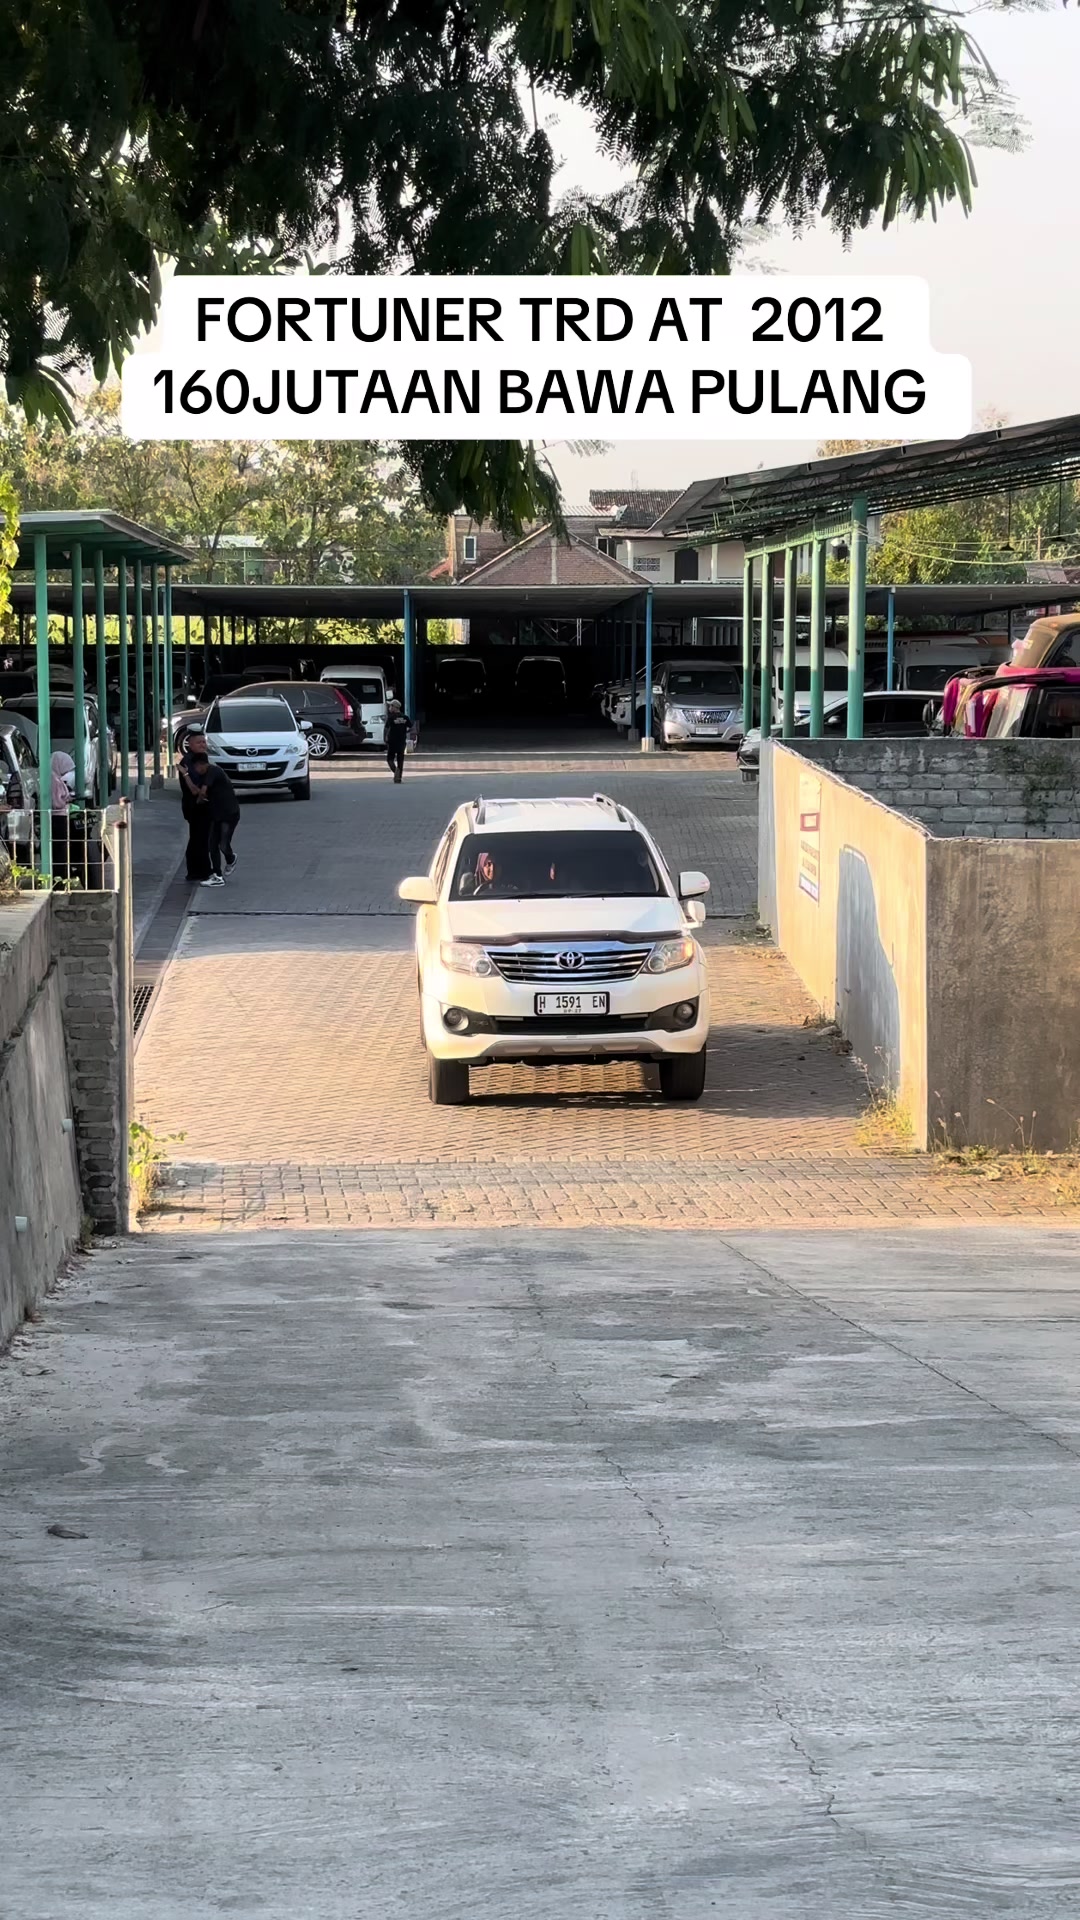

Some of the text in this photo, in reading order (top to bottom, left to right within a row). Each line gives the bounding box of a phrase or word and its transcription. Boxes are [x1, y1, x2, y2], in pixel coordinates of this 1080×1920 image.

[539, 995, 606, 1009] H 1591 EN
